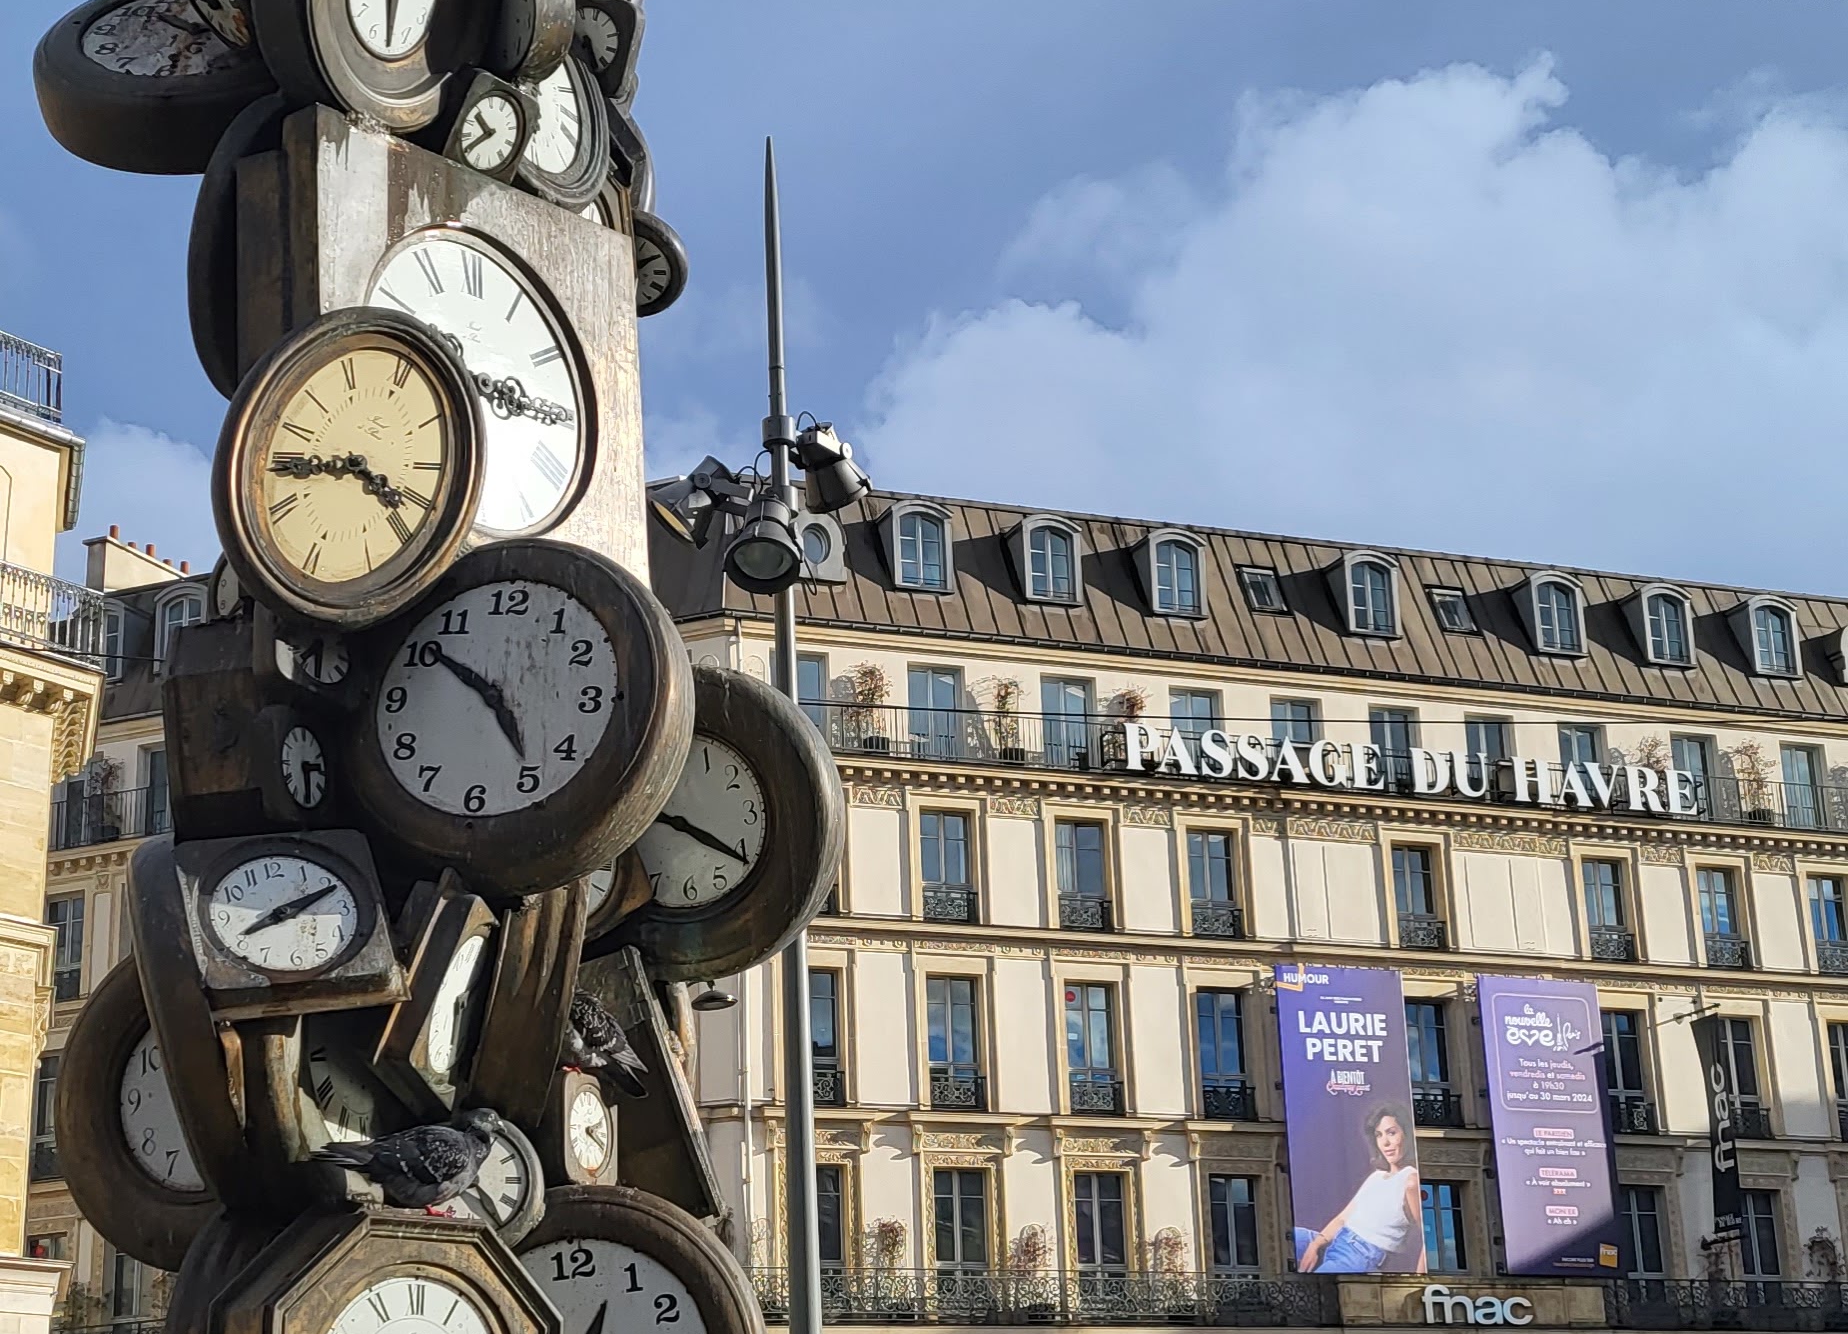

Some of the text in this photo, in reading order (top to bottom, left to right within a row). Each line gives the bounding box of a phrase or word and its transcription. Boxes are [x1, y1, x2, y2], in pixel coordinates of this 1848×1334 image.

[358, 3, 369, 17] 7
[417, 7, 426, 24] 3
[369, 24, 380, 39] 6
[401, 27, 412, 44] 4
[488, 589, 530, 616] 12
[438, 609, 470, 635] 11
[550, 608, 566, 634] 1
[404, 640, 442, 667] 10
[569, 639, 593, 667] 2
[386, 687, 408, 713] 9
[578, 686, 602, 713] 3
[393, 733, 416, 760] 8
[553, 734, 577, 761] 4
[701, 747, 711, 774] 1
[1123, 722, 1698, 815] PASSAGE DU HAVRE
[418, 765, 442, 793] 7
[516, 766, 540, 793] 5
[725, 765, 740, 791] 2
[464, 785, 486, 813] 6
[742, 800, 757, 825] 3
[735, 838, 749, 865] 4
[244, 869, 258, 888] 11
[263, 862, 285, 880] 12
[300, 865, 307, 883] 1
[712, 865, 728, 890] 5
[224, 885, 244, 904] 10
[683, 875, 698, 900] 6
[218, 910, 230, 927] 9
[337, 900, 350, 916] 3
[236, 934, 249, 950] 8
[332, 925, 345, 942] 4
[260, 947, 271, 963] 7
[290, 949, 303, 966] 6
[316, 943, 328, 959] 5
[1283, 972, 1329, 984] HUMOUR
[1298, 1010, 1387, 1036] LAURIE
[1504, 1012, 1553, 1027] nouvelle
[1306, 1037, 1383, 1062] PERET
[1510, 1069, 1545, 1078] vendredis
[1519, 1058, 1537, 1067] Tous
[1538, 1059, 1548, 1068] les
[1540, 1092, 1550, 1100] 30
[1572, 1093, 1592, 1102] 2024
[1541, 1081, 1564, 1090] 19h30
[128, 1088, 141, 1115] 9
[1711, 1063, 1734, 1172] fnac
[142, 1128, 156, 1156] 8
[165, 1150, 179, 1178] 7
[551, 1249, 596, 1281] 12
[624, 1263, 644, 1293] 1
[654, 1293, 680, 1325] 2
[1422, 1284, 1534, 1325] fnac
